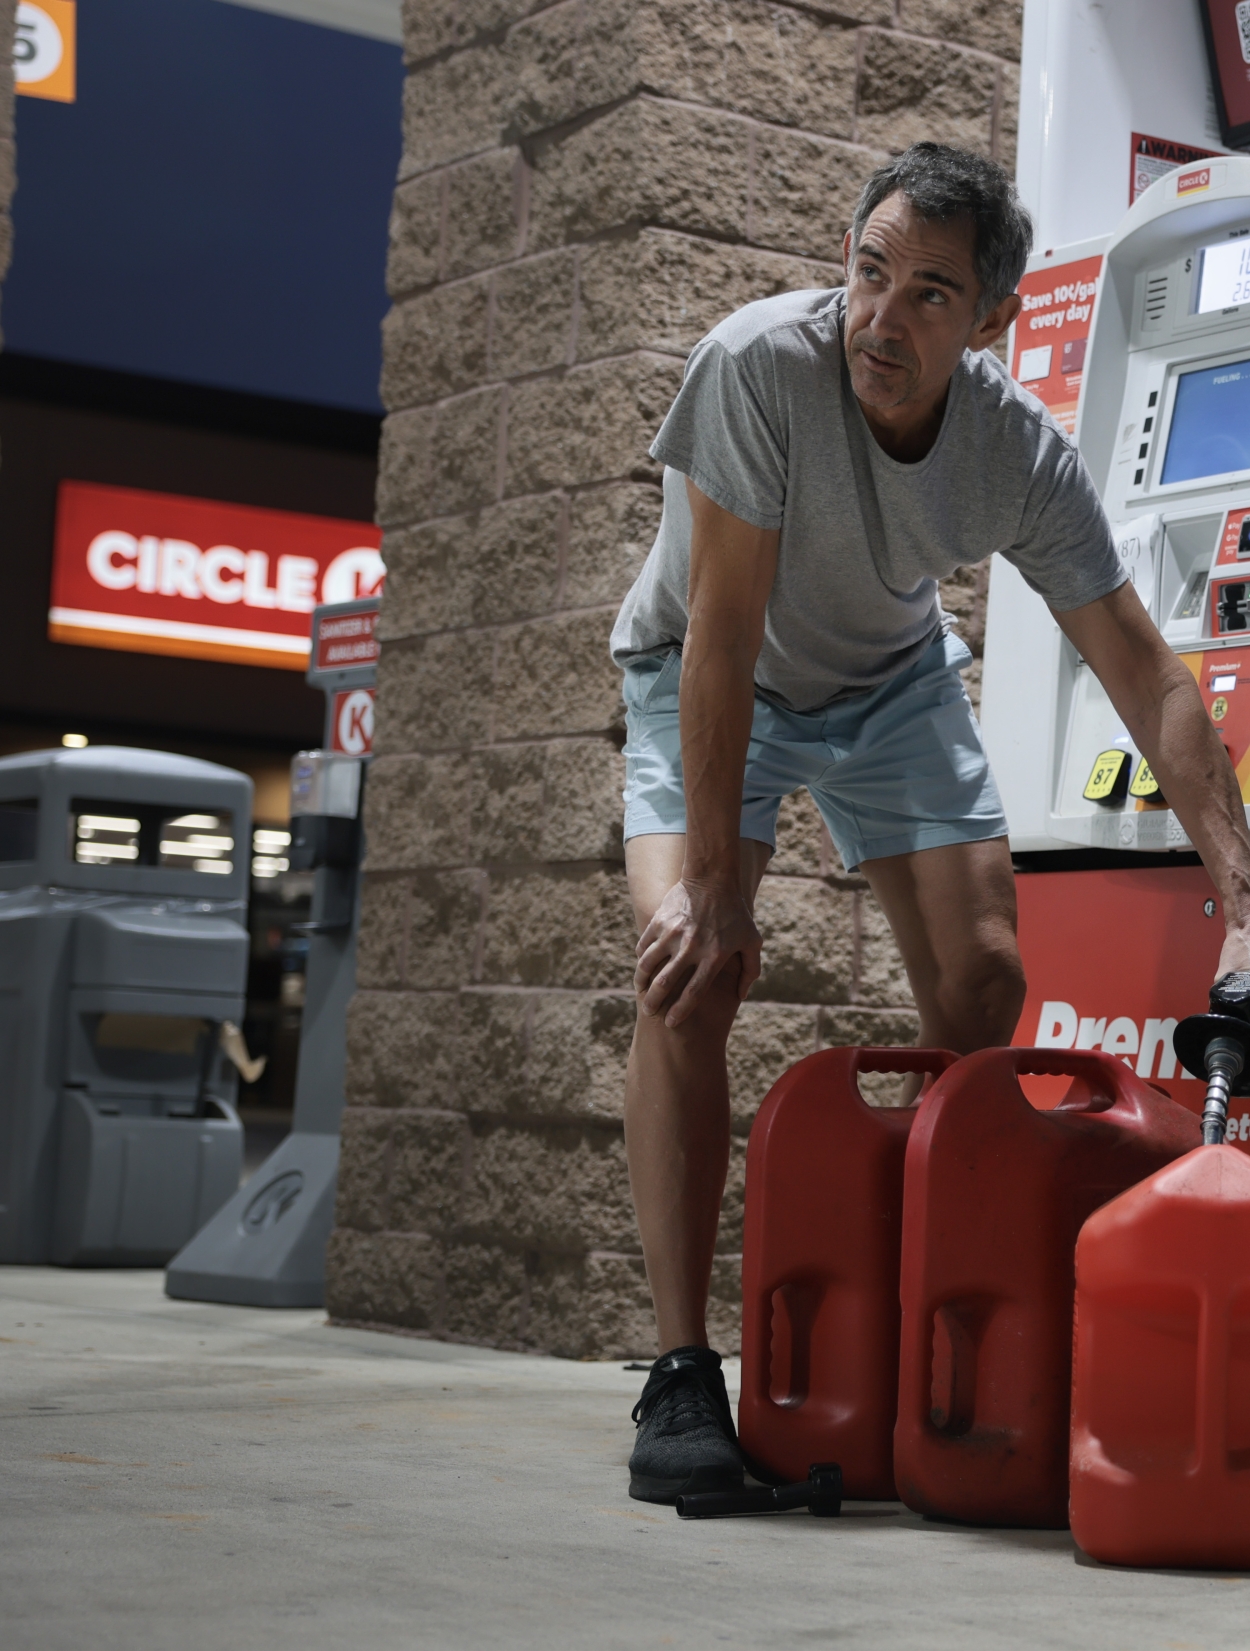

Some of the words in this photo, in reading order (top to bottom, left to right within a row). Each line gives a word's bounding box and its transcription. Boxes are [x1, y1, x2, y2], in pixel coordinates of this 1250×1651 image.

[1178, 177, 1199, 189] CIRCLE
[1185, 258, 1192, 273] $
[1022, 293, 1052, 312] Save
[1029, 310, 1065, 330] every
[1066, 303, 1091, 324] day
[86, 529, 319, 614] CIRCLE
[1209, 661, 1241, 673] Premium+
[349, 703, 373, 748] K
[1093, 768, 1114, 786] 87
